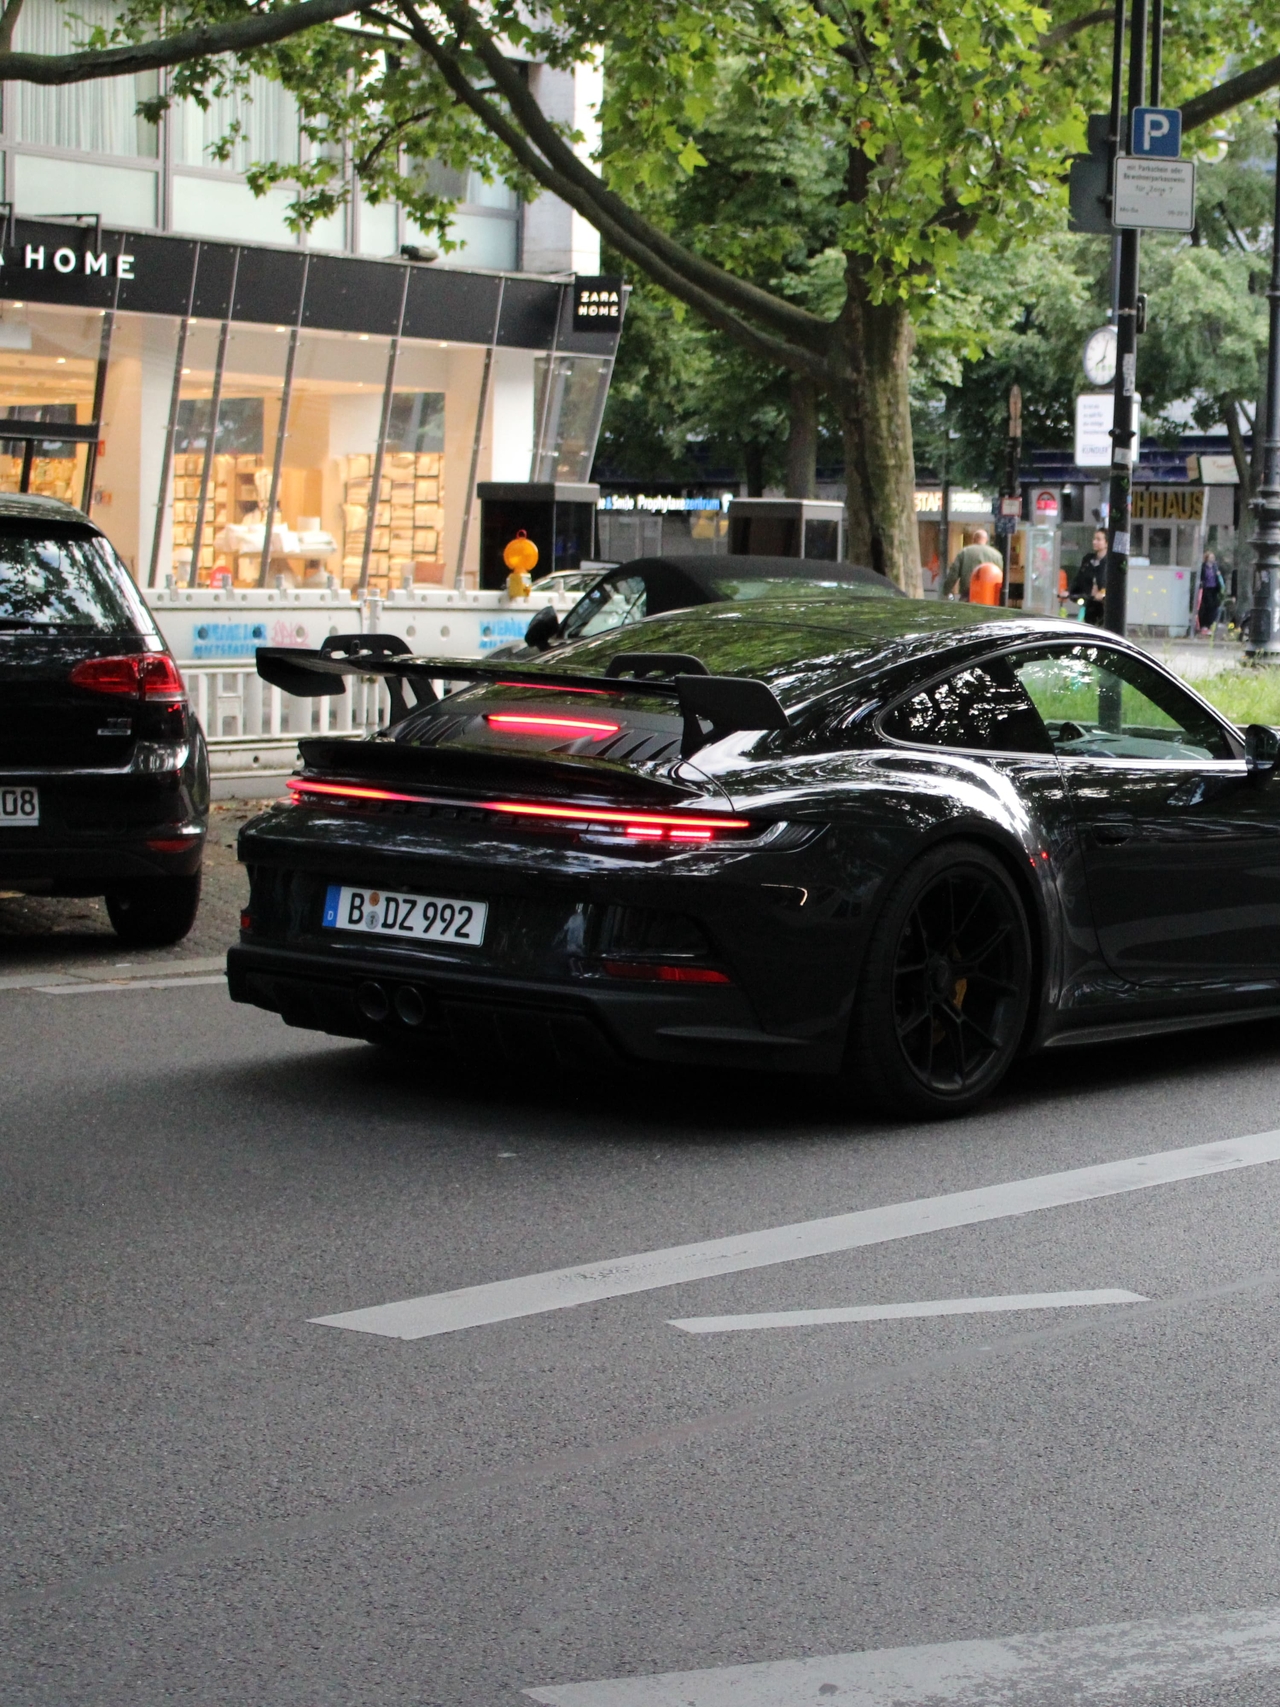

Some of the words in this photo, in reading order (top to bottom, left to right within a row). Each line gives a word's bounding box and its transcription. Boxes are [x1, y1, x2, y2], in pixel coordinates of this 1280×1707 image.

[1143, 113, 1170, 151] P
[25, 244, 135, 279] HOME
[578, 304, 619, 317] HOME
[580, 291, 619, 303] ZARA
[348, 892, 365, 924] B
[381, 896, 418, 932] DZ
[422, 901, 473, 939] 992
